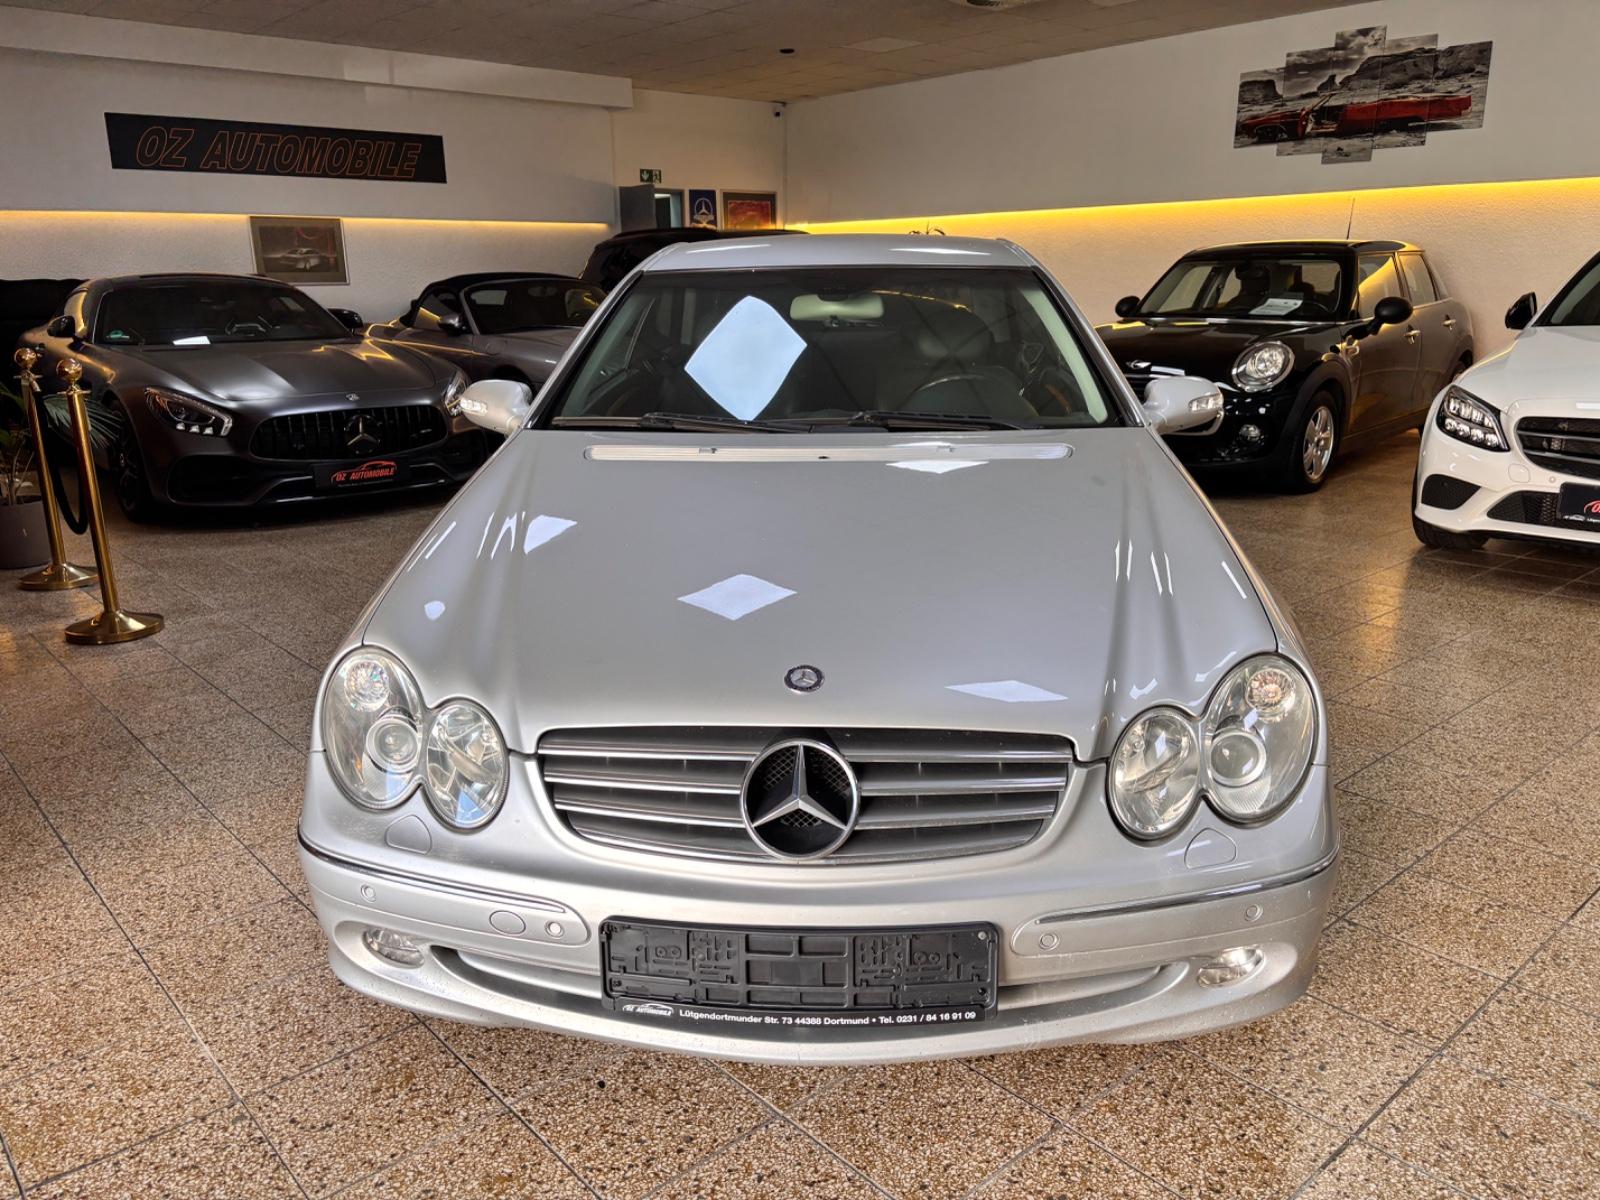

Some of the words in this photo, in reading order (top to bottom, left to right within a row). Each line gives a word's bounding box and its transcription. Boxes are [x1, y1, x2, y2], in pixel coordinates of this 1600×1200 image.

[136, 127, 194, 167] OZ
[200, 131, 421, 178] AUTOMOBILE
[350, 468, 394, 480] AUTOMOBILE
[679, 1009, 762, 1023] Lütgendortmunder
[764, 1016, 780, 1025] Str.
[782, 1017, 793, 1025] 73
[794, 1018, 822, 1026] 44388
[823, 1018, 869, 1026] Dortmund
[879, 1016, 894, 1025] Tel.
[896, 1014, 917, 1024] 0231
[926, 1013, 937, 1022] 84
[951, 1012, 963, 1021] 91
[964, 1011, 976, 1020] 09
